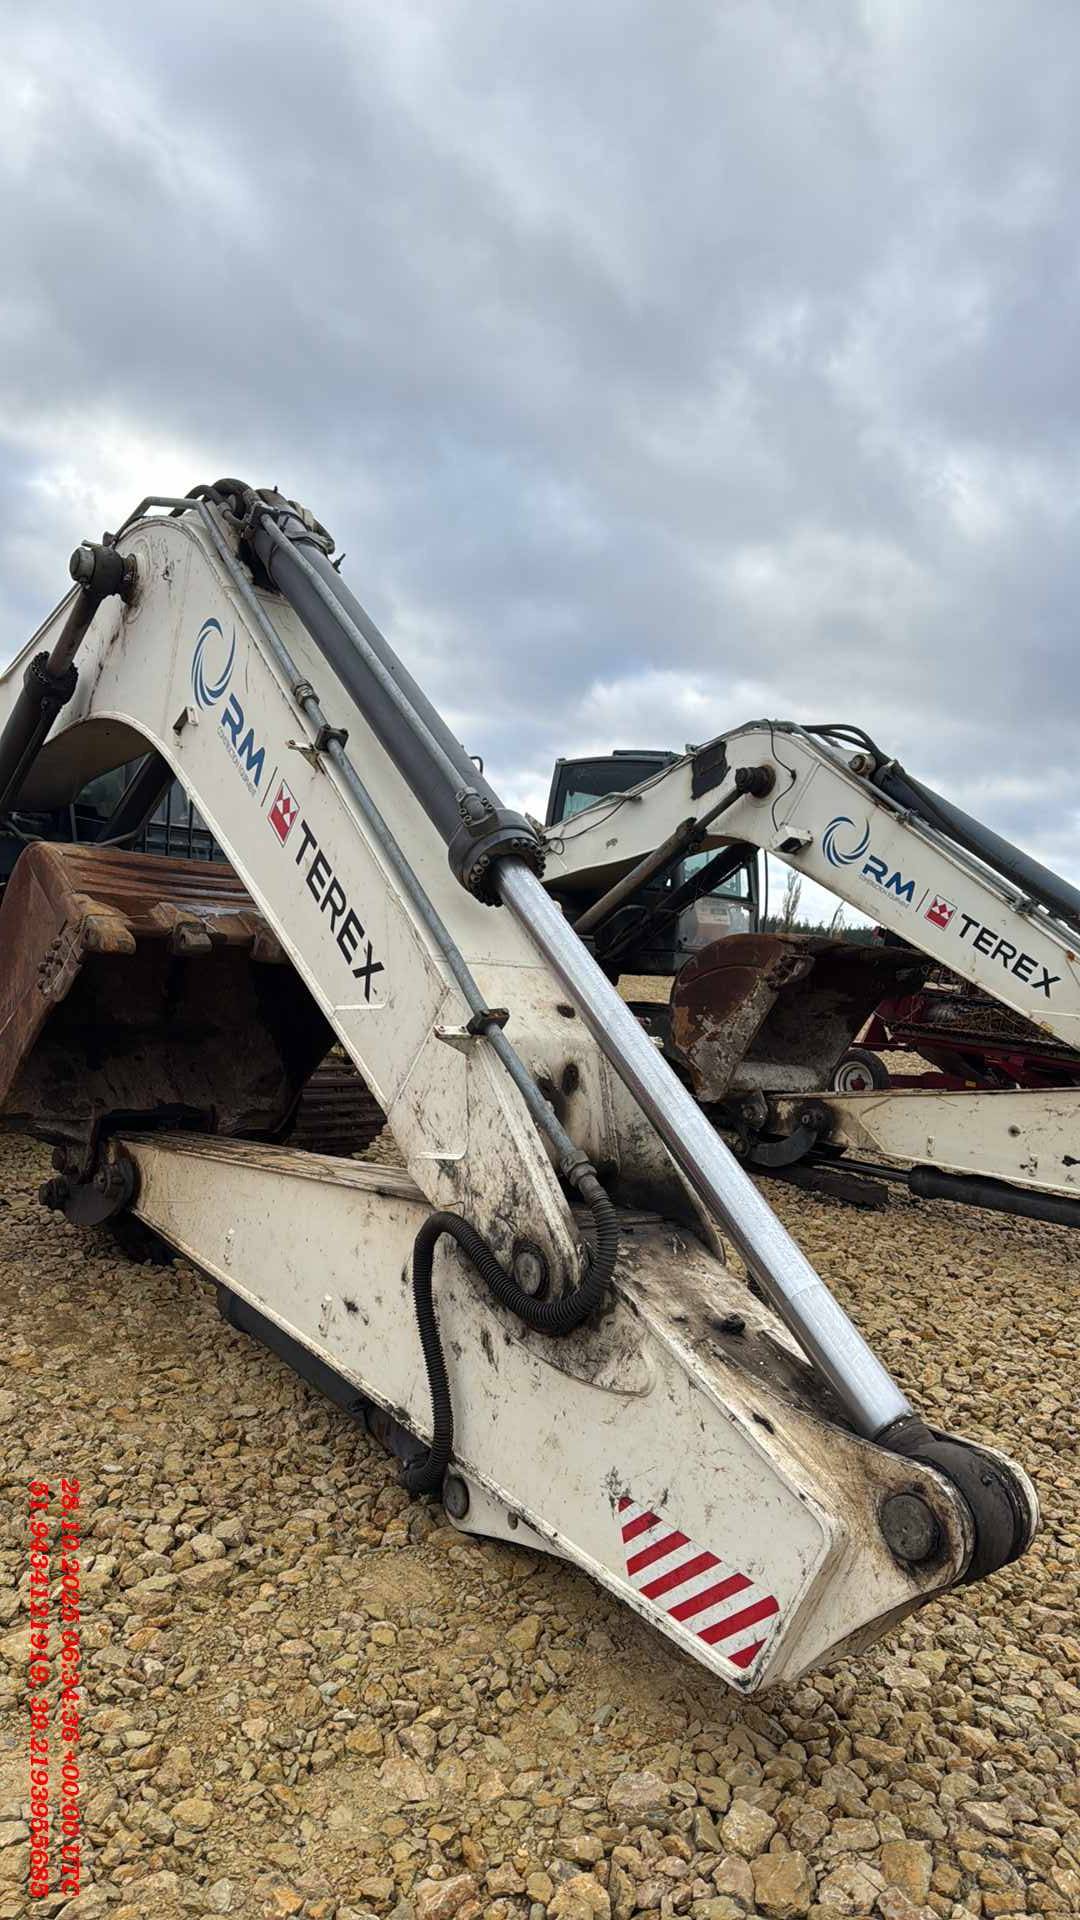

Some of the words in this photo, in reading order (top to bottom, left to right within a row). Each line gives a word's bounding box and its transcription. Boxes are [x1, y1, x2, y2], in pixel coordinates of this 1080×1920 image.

[221, 693, 266, 786] RM
[294, 819, 385, 1002] TEREX
[861, 854, 916, 903] RM
[957, 912, 1062, 998] TEREX
